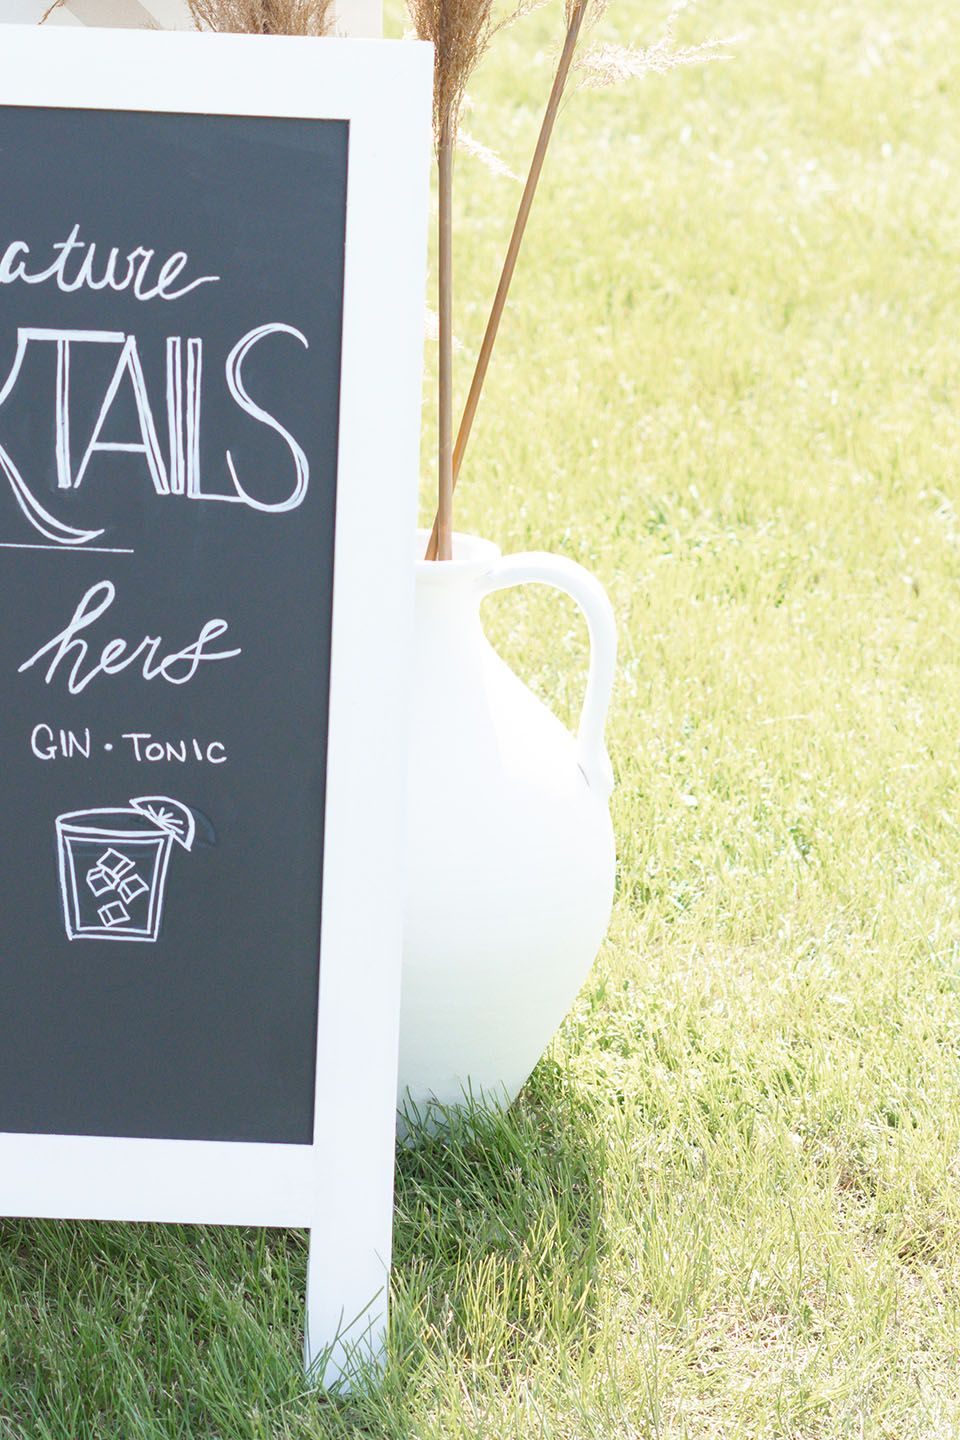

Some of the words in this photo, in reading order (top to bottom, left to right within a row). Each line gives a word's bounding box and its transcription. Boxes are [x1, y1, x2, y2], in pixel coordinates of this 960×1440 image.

[17, 579, 242, 695] hers
[30, 723, 91, 761] GIN
[121, 732, 228, 765] TONIC
